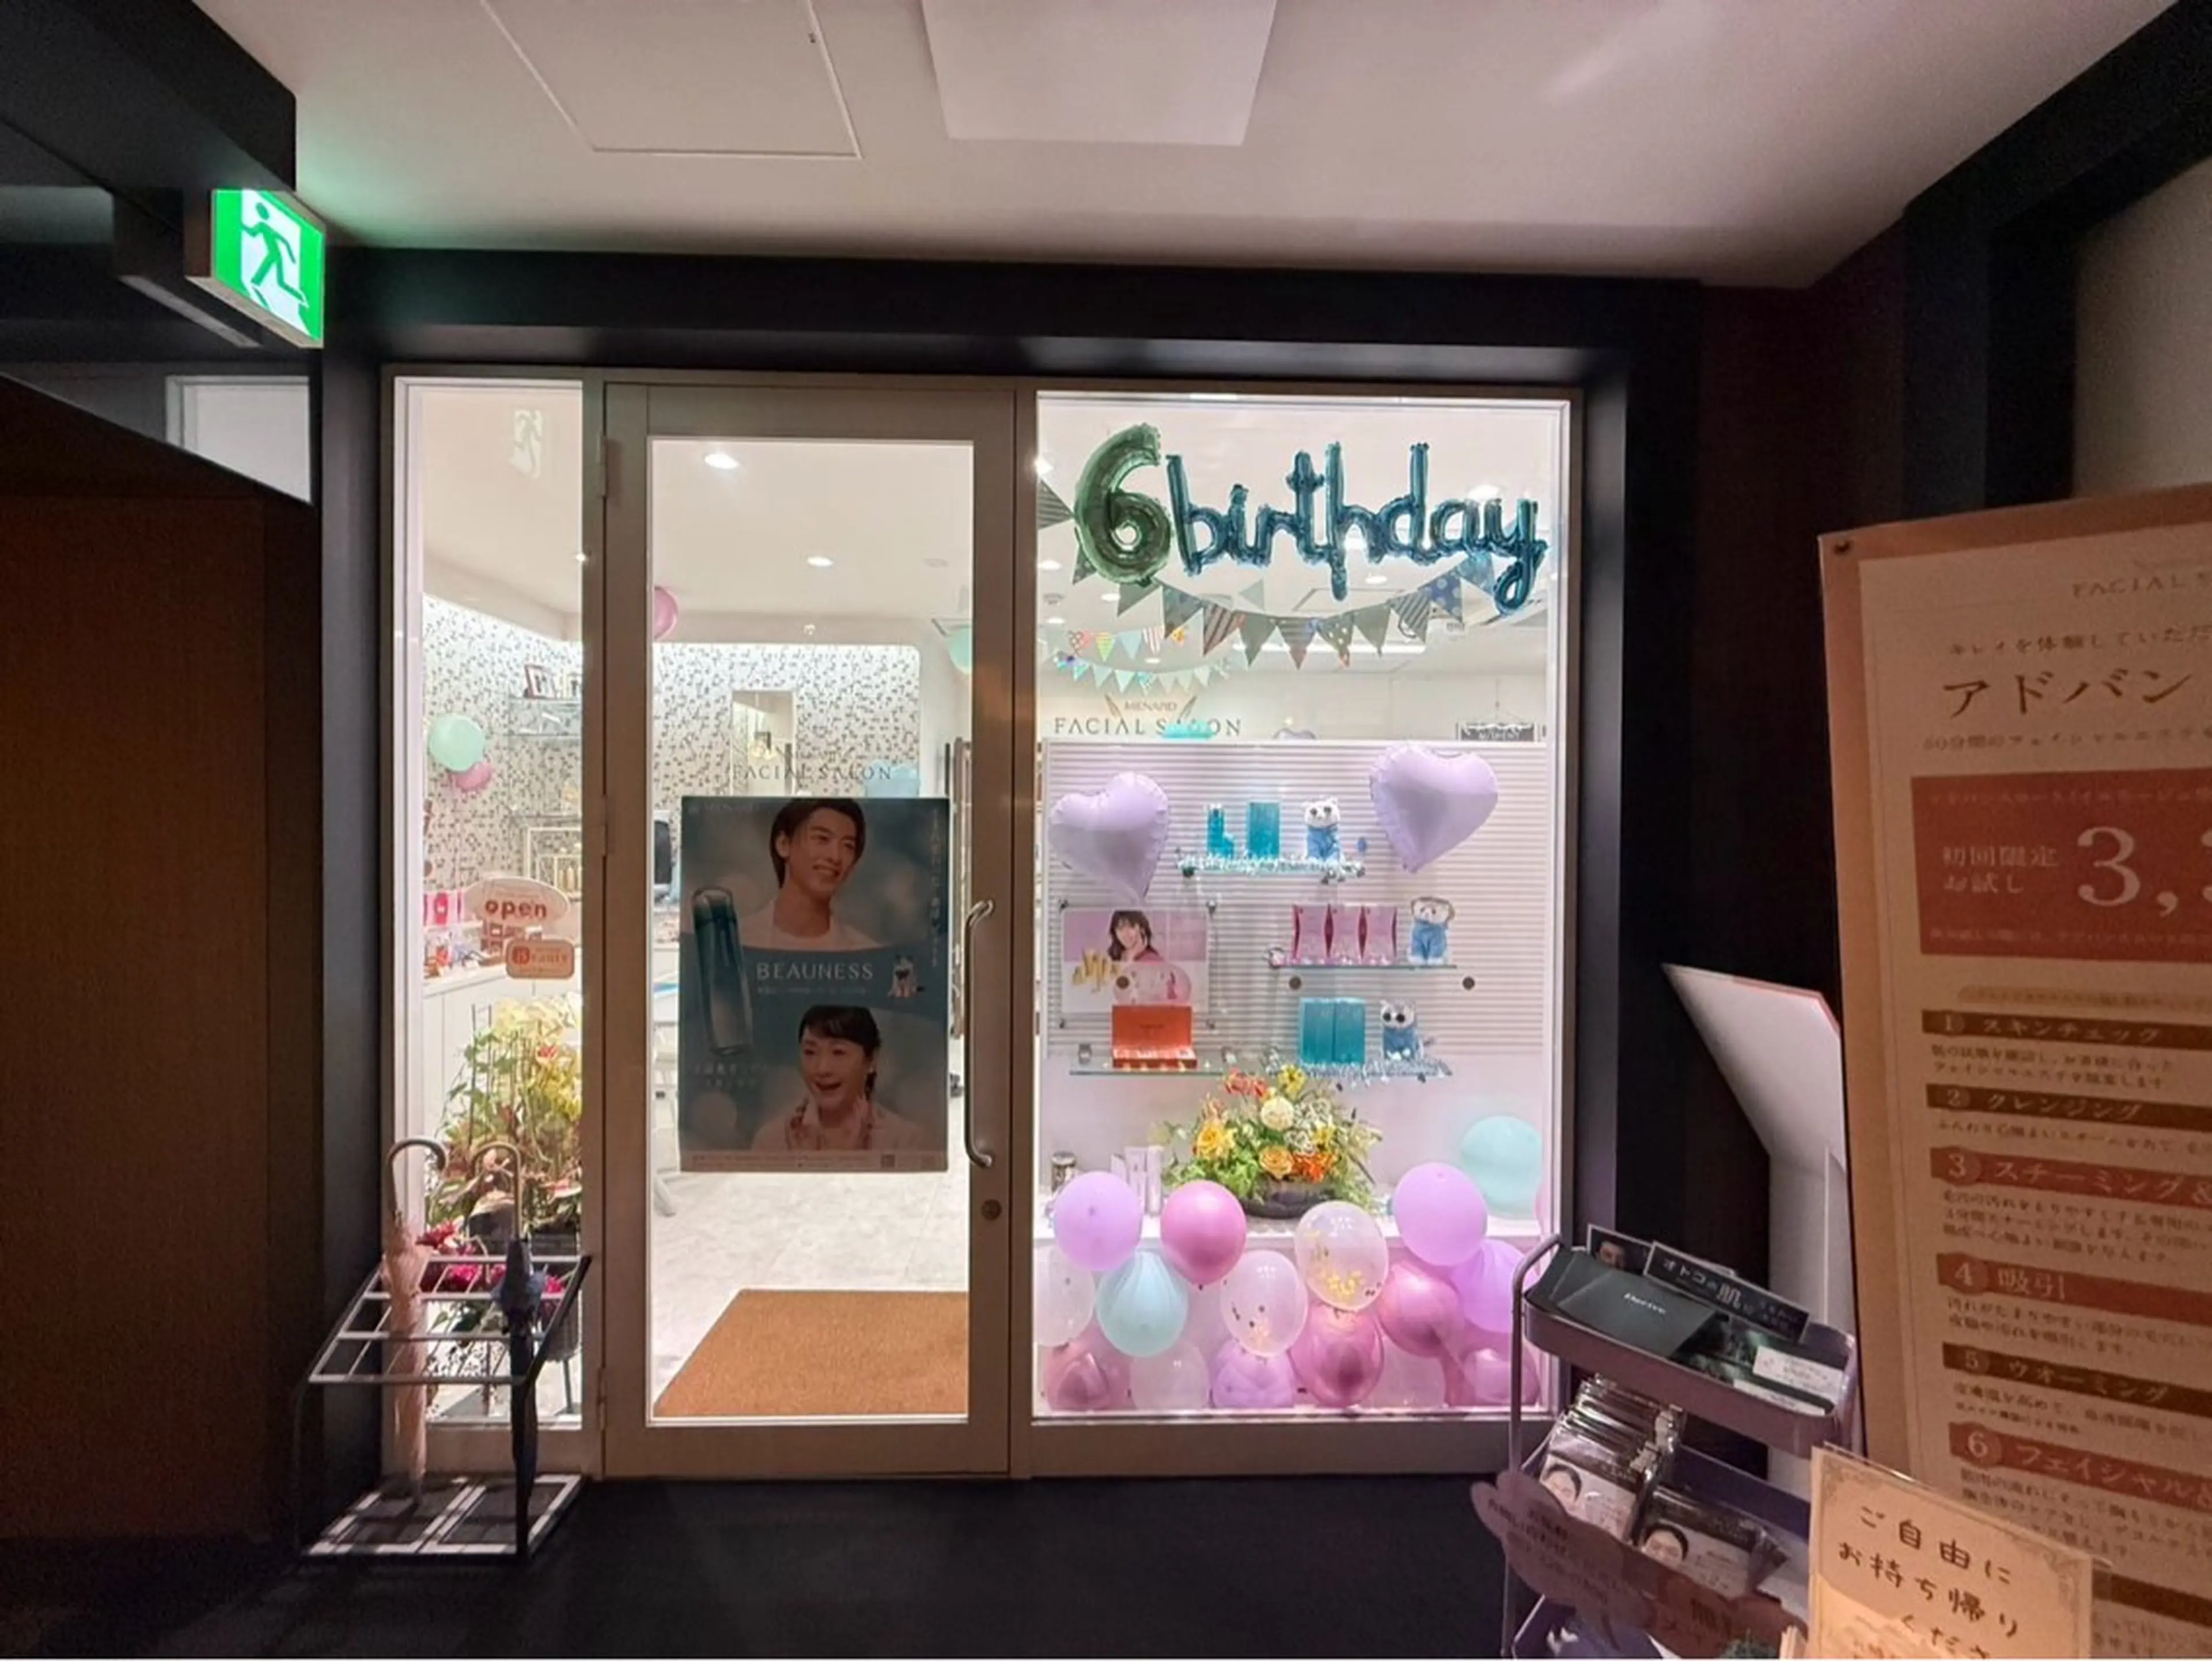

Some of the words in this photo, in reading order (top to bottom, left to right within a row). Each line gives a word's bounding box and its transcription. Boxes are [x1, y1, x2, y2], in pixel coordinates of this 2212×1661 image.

[1074, 423, 1173, 587] 6
[1166, 441, 1548, 616] birthday
[2072, 574, 2186, 597] FACIAL
[1942, 667, 2193, 718] アドバン
[1054, 717, 1145, 735] FACIAL
[1156, 718, 1241, 737] SON
[2077, 826, 2212, 918] 3,
[485, 899, 547, 920] open
[756, 962, 874, 980] BEAUNESS
[1982, 1017, 2162, 1041] スキンチェック
[1987, 1093, 2142, 1122] クレンジング
[1955, 1262, 1974, 1287] 4
[1997, 1267, 2065, 1300] 吸引
[1967, 1431, 1988, 1458] 6
[1860, 1505, 2011, 1585] ご自由に
[1839, 1542, 2018, 1639] お持ち帰り
